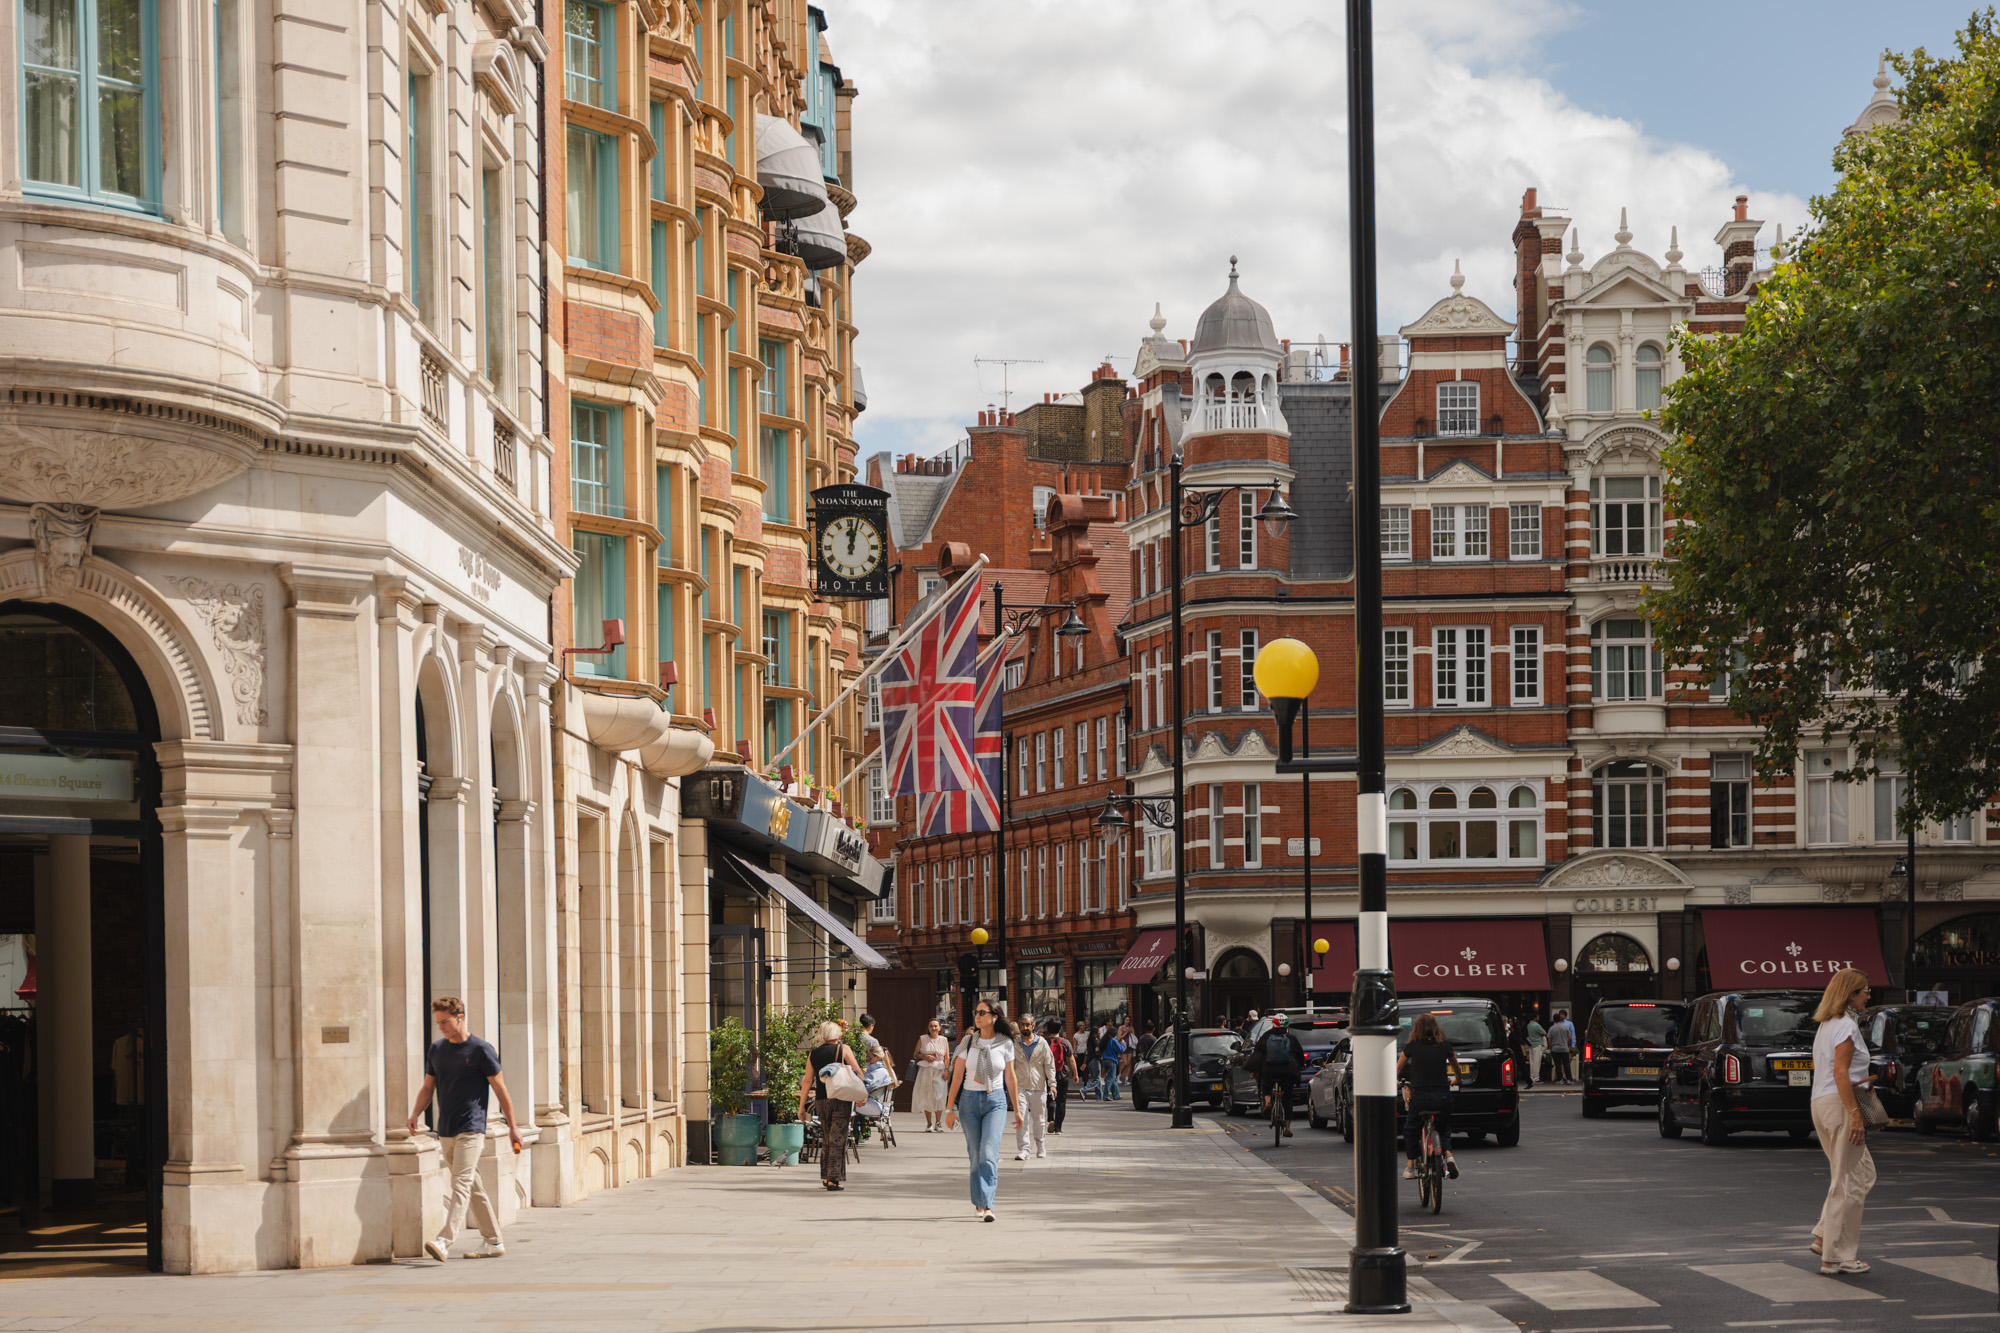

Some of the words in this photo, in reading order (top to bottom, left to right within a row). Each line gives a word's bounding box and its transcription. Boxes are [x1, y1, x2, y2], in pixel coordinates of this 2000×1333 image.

[842, 490, 858, 498] THE
[817, 498, 850, 506] SLOANE
[850, 498, 884, 507] SQUARE
[820, 580, 885, 591] HOTEL
[58, 775, 102, 791] Square
[1572, 898, 1658, 912] COLBERT
[1121, 955, 1165, 970] COLBERT
[1740, 960, 1853, 974] COLBERT
[1413, 963, 1527, 977] COLBERT
[1781, 1060, 1795, 1069] R16
[1796, 1060, 1812, 1069] TXE
